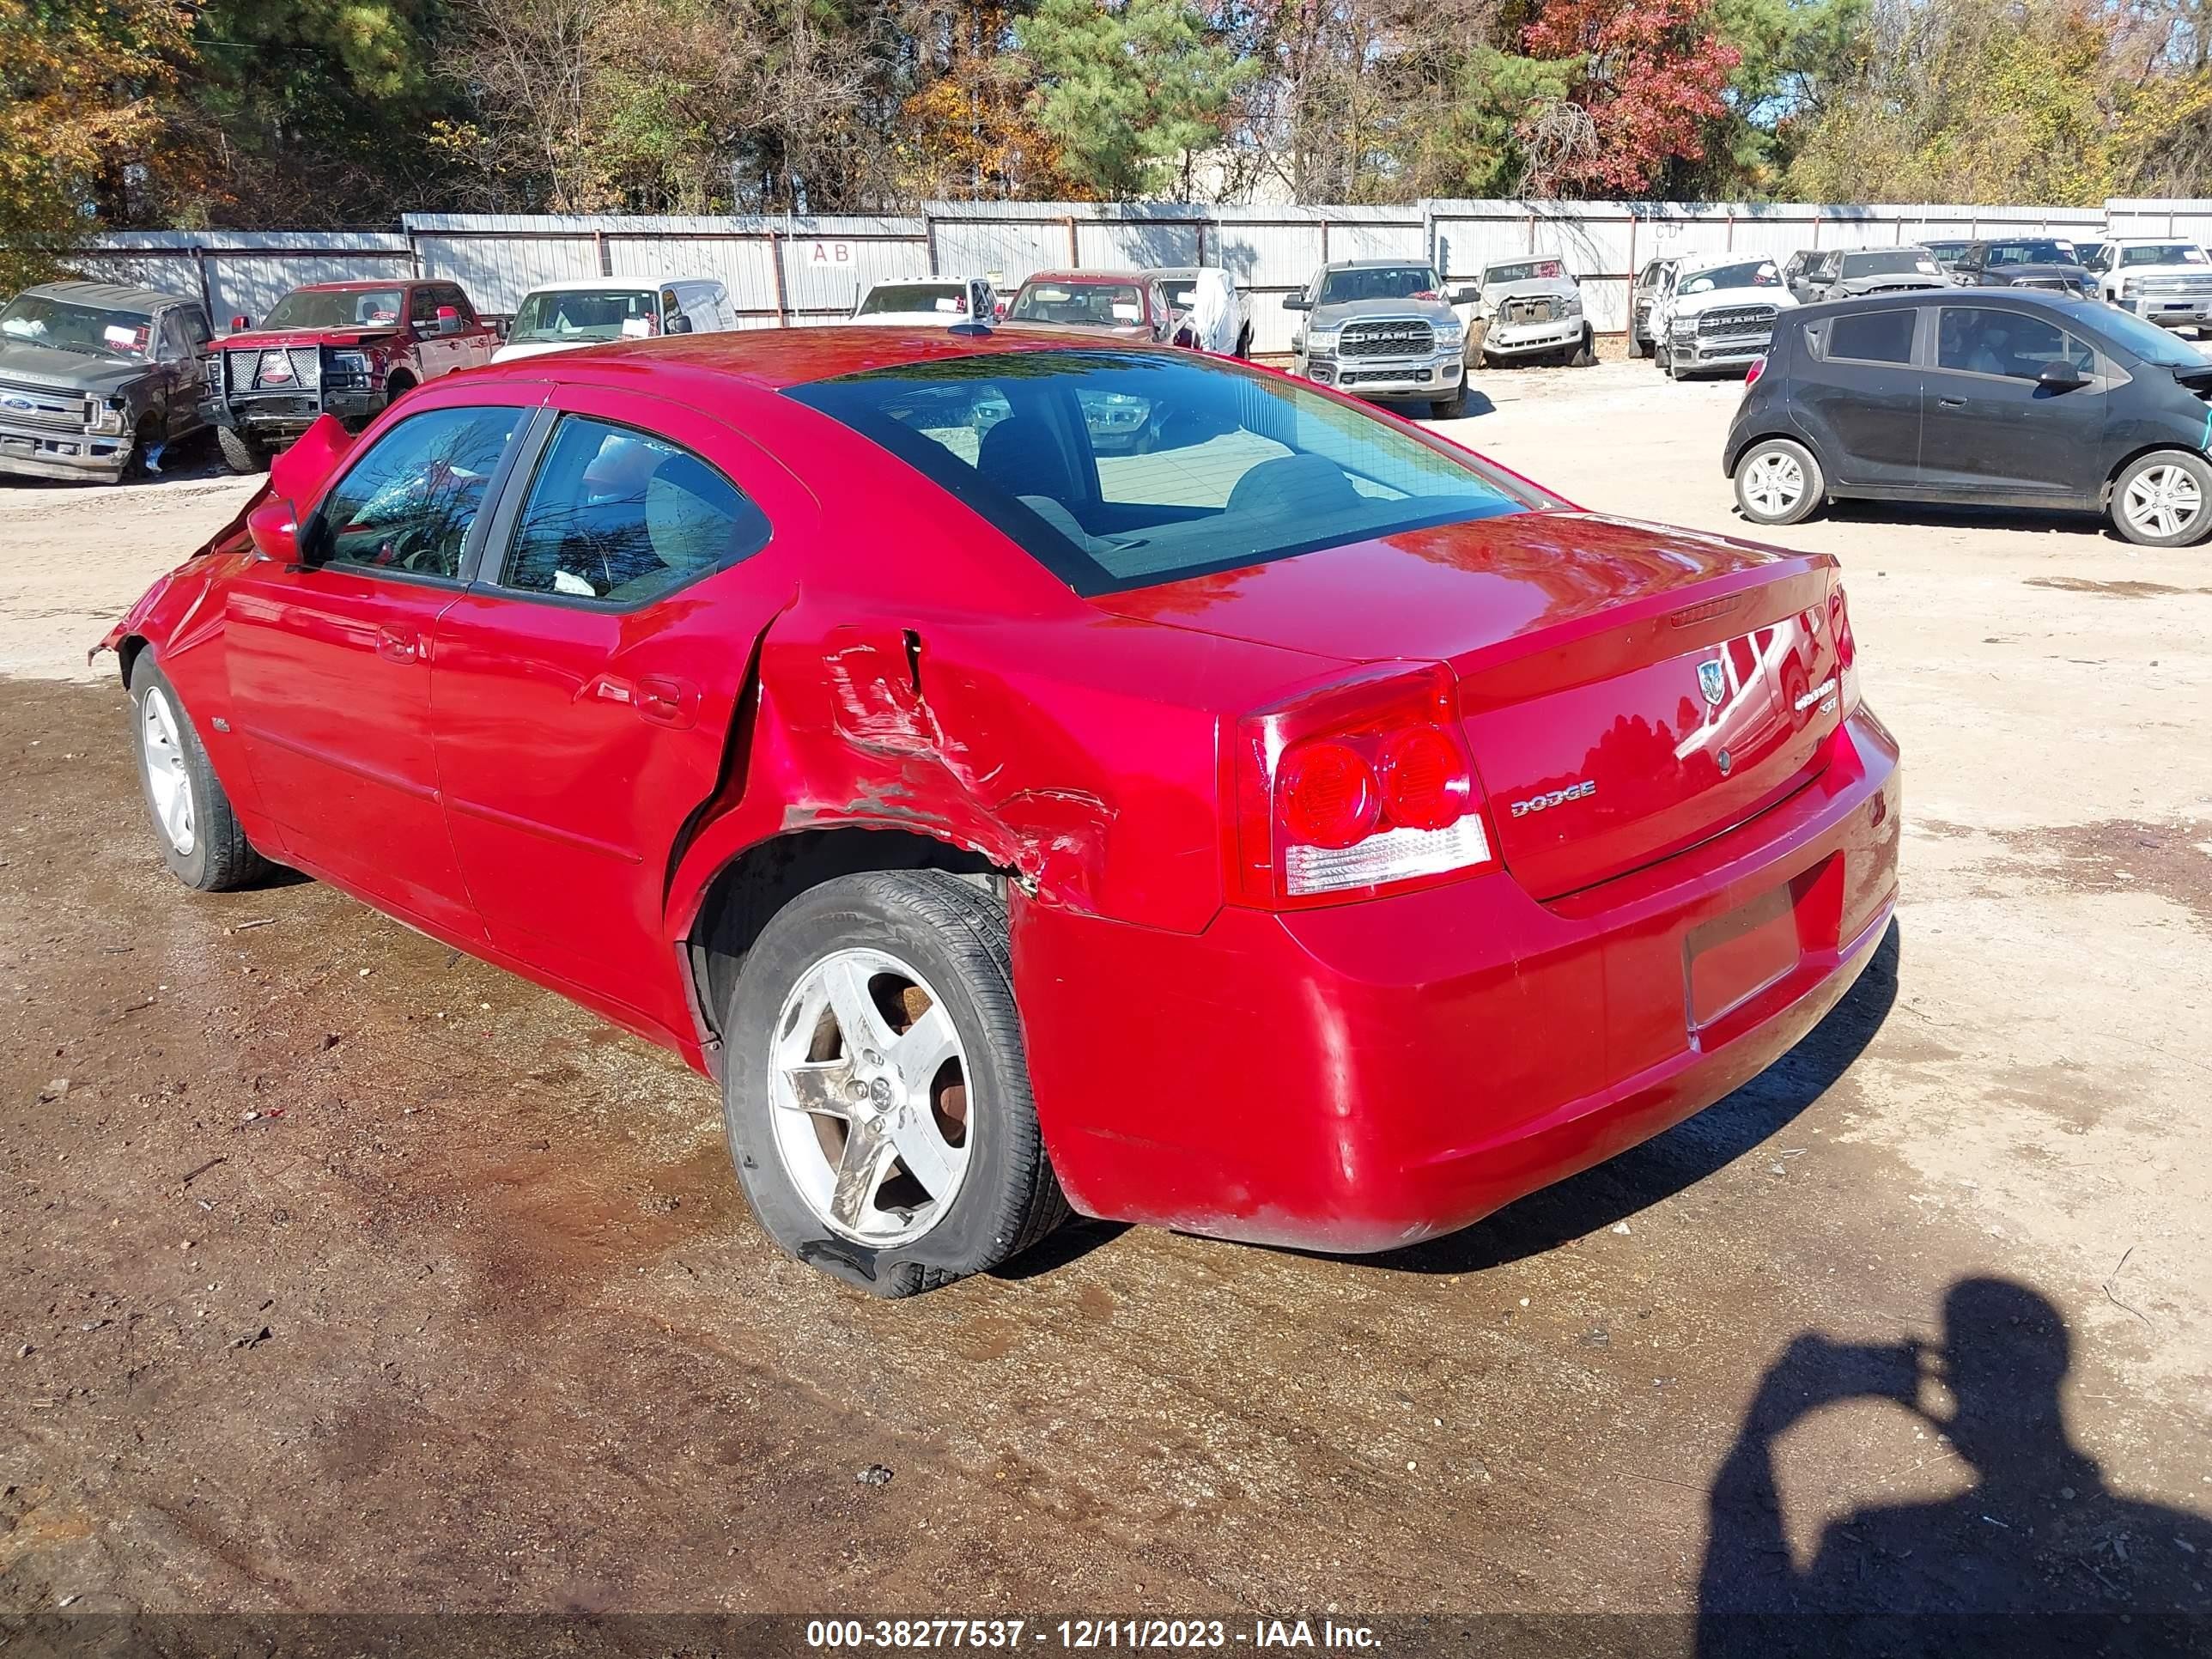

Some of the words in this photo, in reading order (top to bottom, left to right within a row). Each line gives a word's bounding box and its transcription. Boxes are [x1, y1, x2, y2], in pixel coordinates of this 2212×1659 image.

[1721, 315, 1754, 325] RAM
[1366, 331, 1407, 341] RAM
[1510, 779, 1596, 817] DODGE
